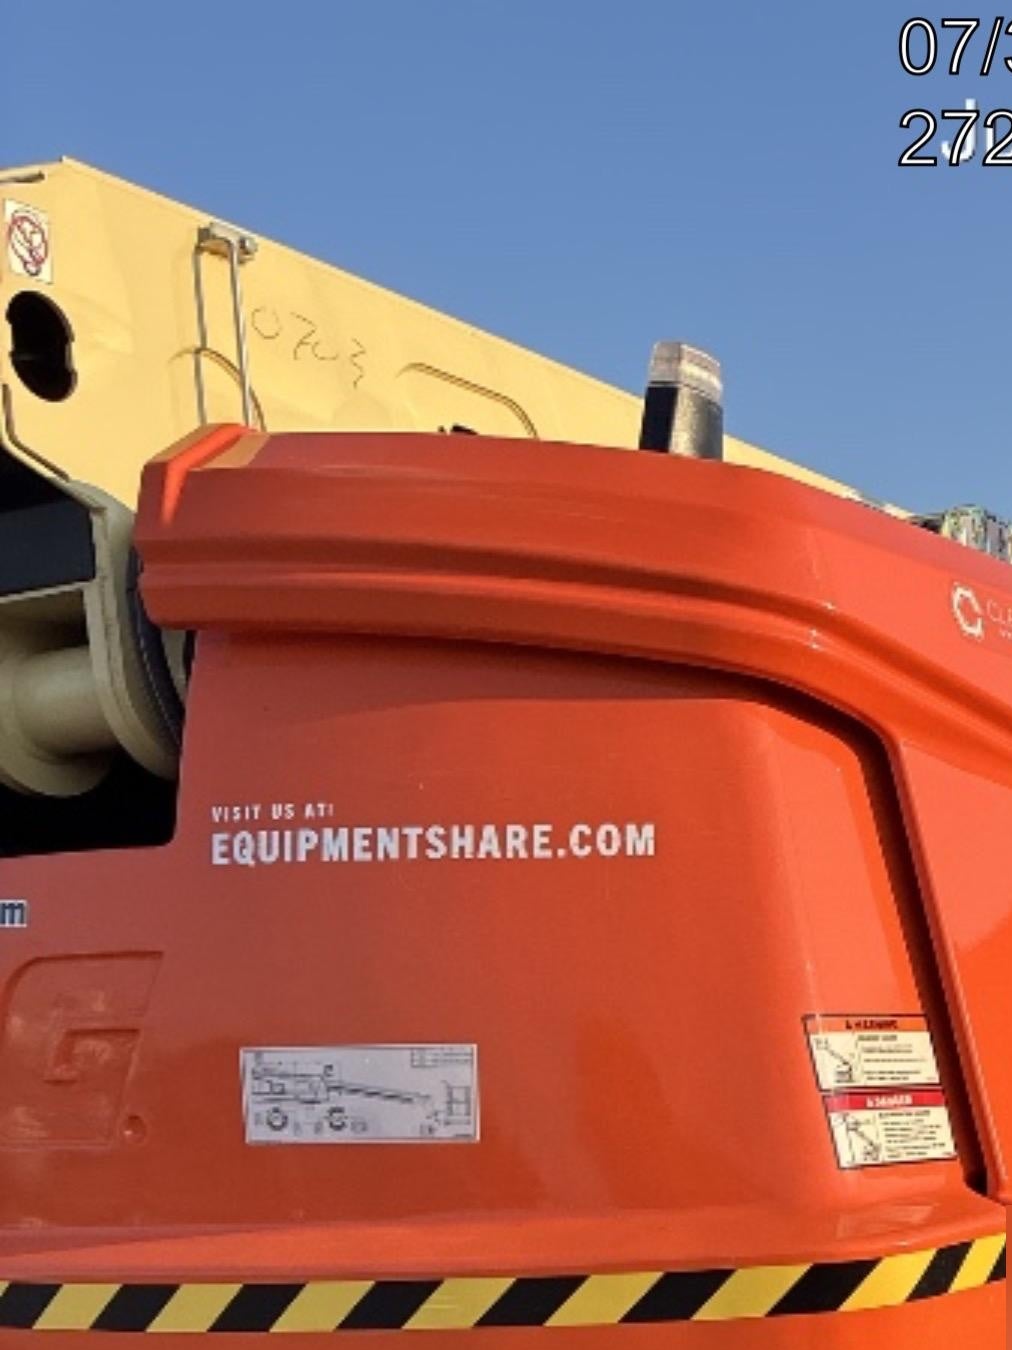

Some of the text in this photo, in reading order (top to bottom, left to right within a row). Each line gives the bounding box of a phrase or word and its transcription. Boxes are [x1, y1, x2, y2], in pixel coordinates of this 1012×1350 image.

[210, 805, 262, 823] VISIT
[270, 802, 296, 820] US
[210, 822, 657, 867] EQUIPMENTSHARE.COM
